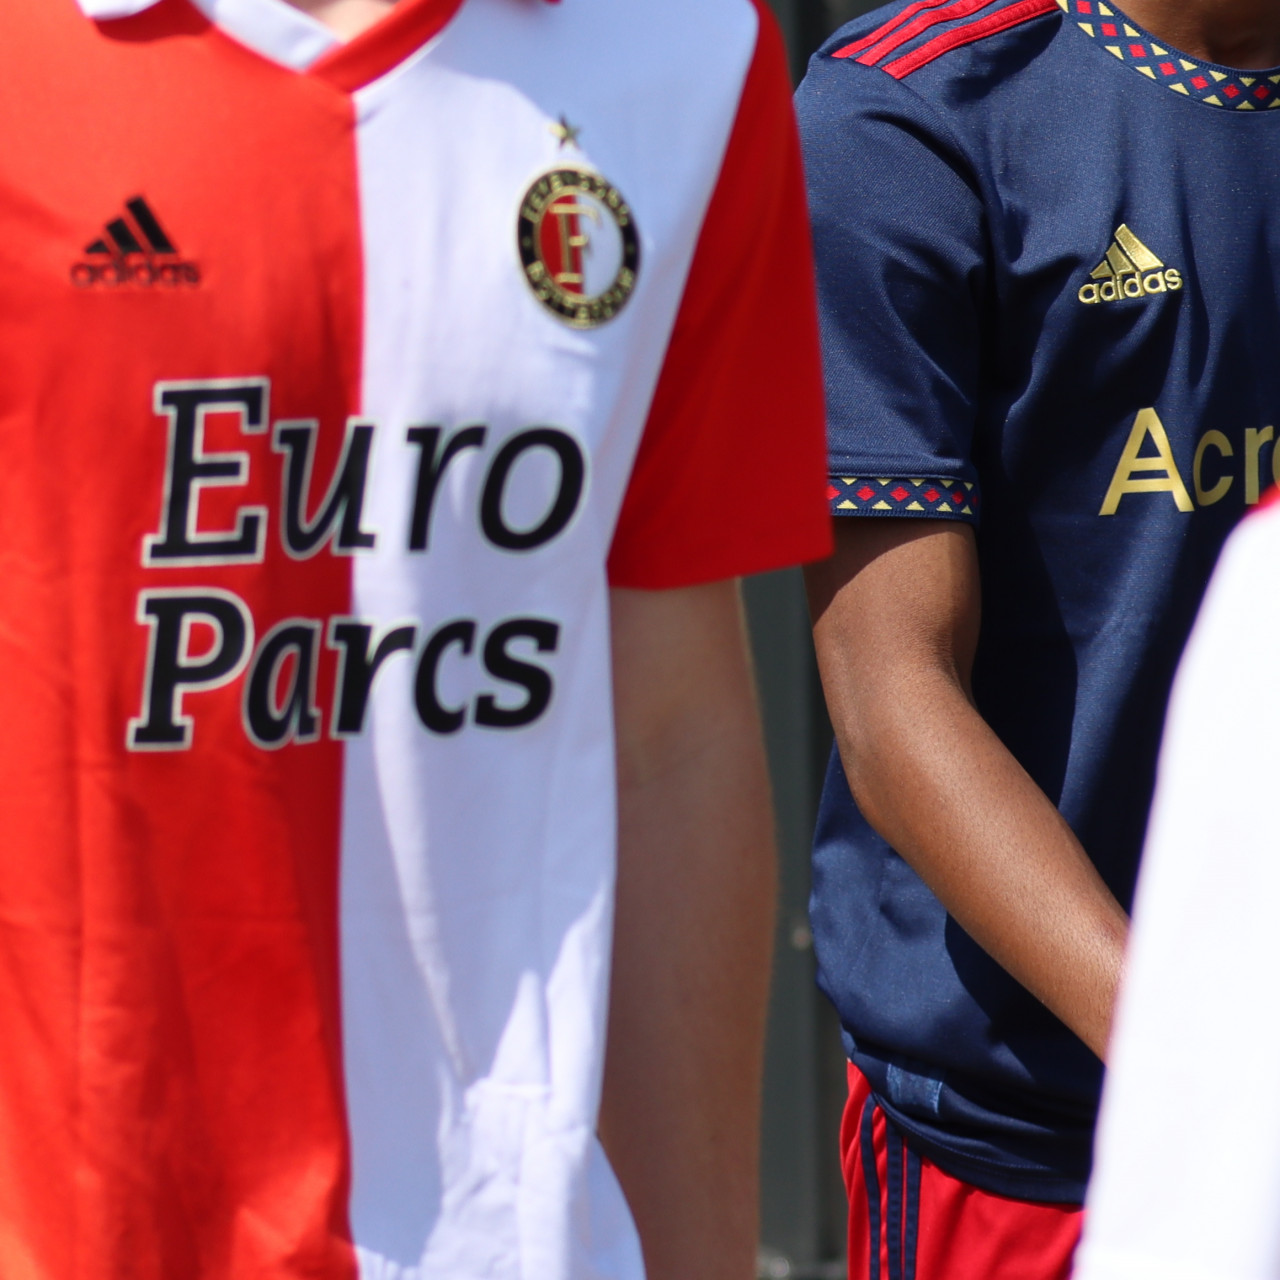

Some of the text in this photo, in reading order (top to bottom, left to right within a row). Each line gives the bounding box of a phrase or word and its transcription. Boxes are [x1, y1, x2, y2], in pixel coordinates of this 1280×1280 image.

[1078, 268, 1183, 304] adidas
[141, 376, 589, 568] Euro
[126, 586, 561, 752] Parcs
